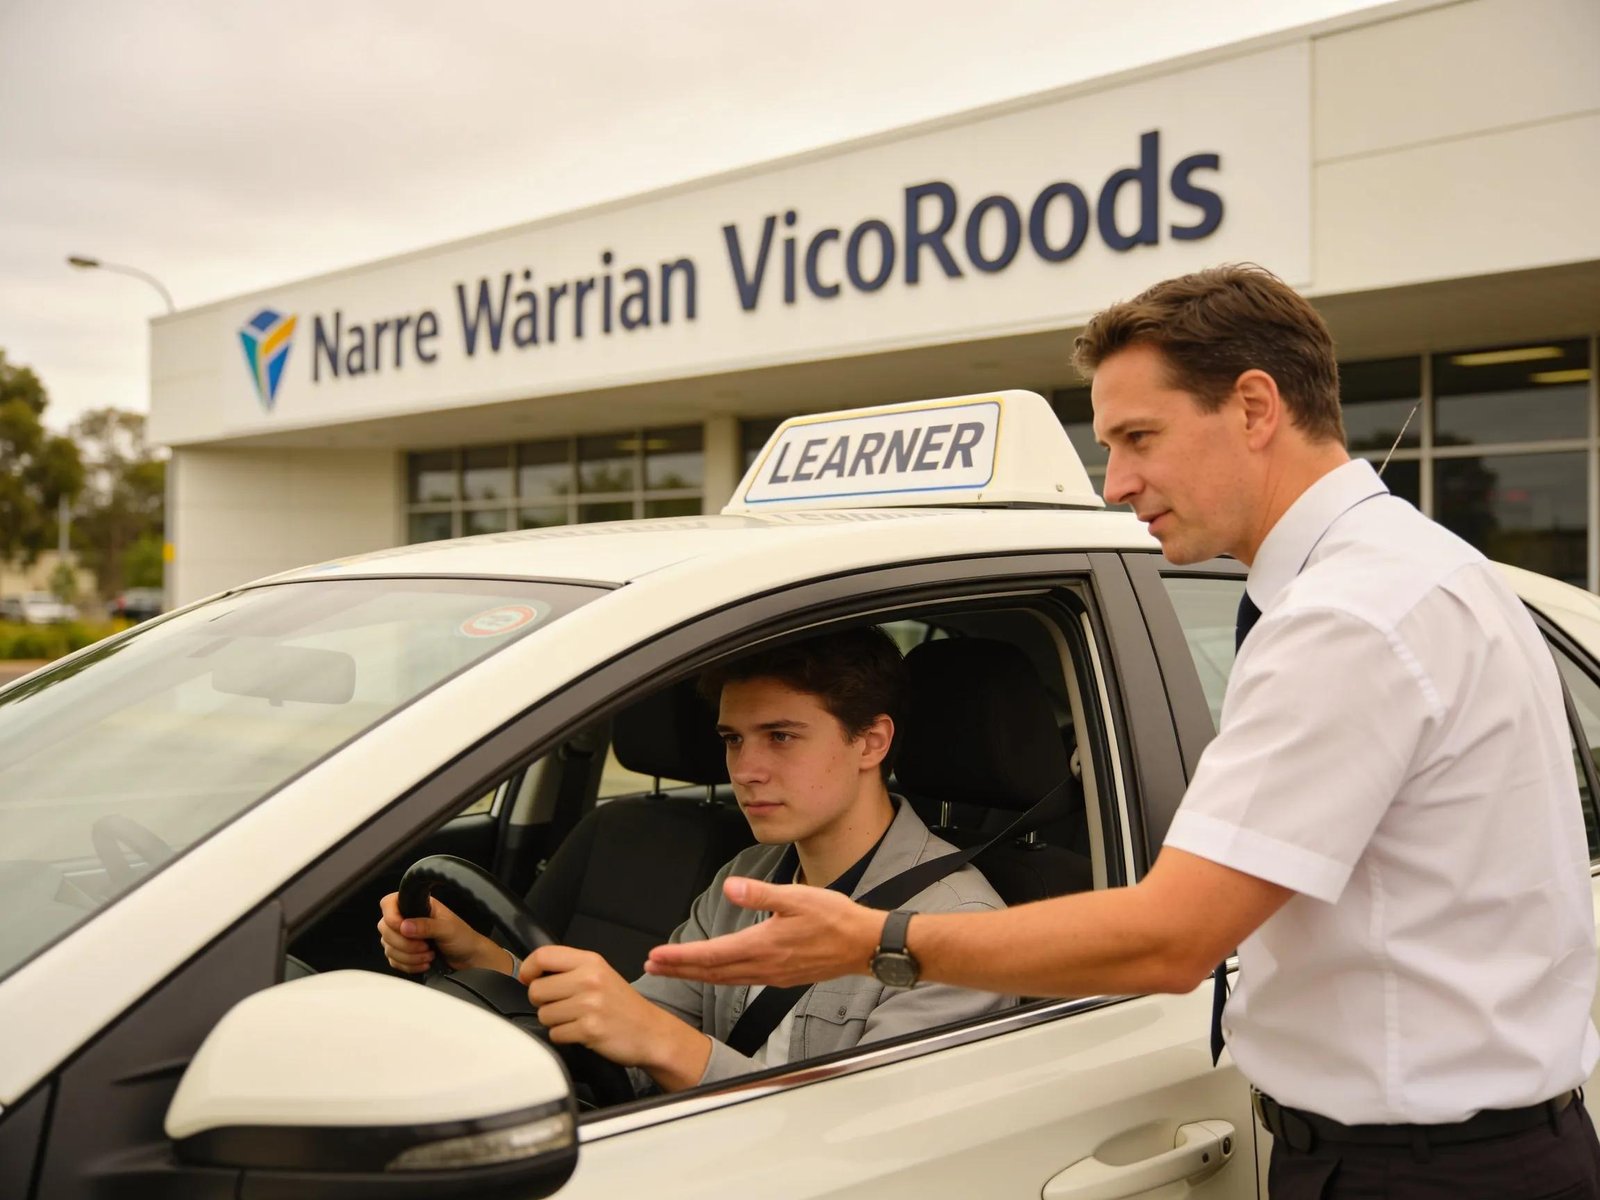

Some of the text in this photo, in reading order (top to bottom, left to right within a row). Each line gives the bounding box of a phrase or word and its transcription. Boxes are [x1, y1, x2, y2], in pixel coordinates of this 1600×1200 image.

[312, 309, 438, 383] Narre
[722, 129, 1225, 312] VicoRoods
[768, 421, 985, 485] LEARNER
